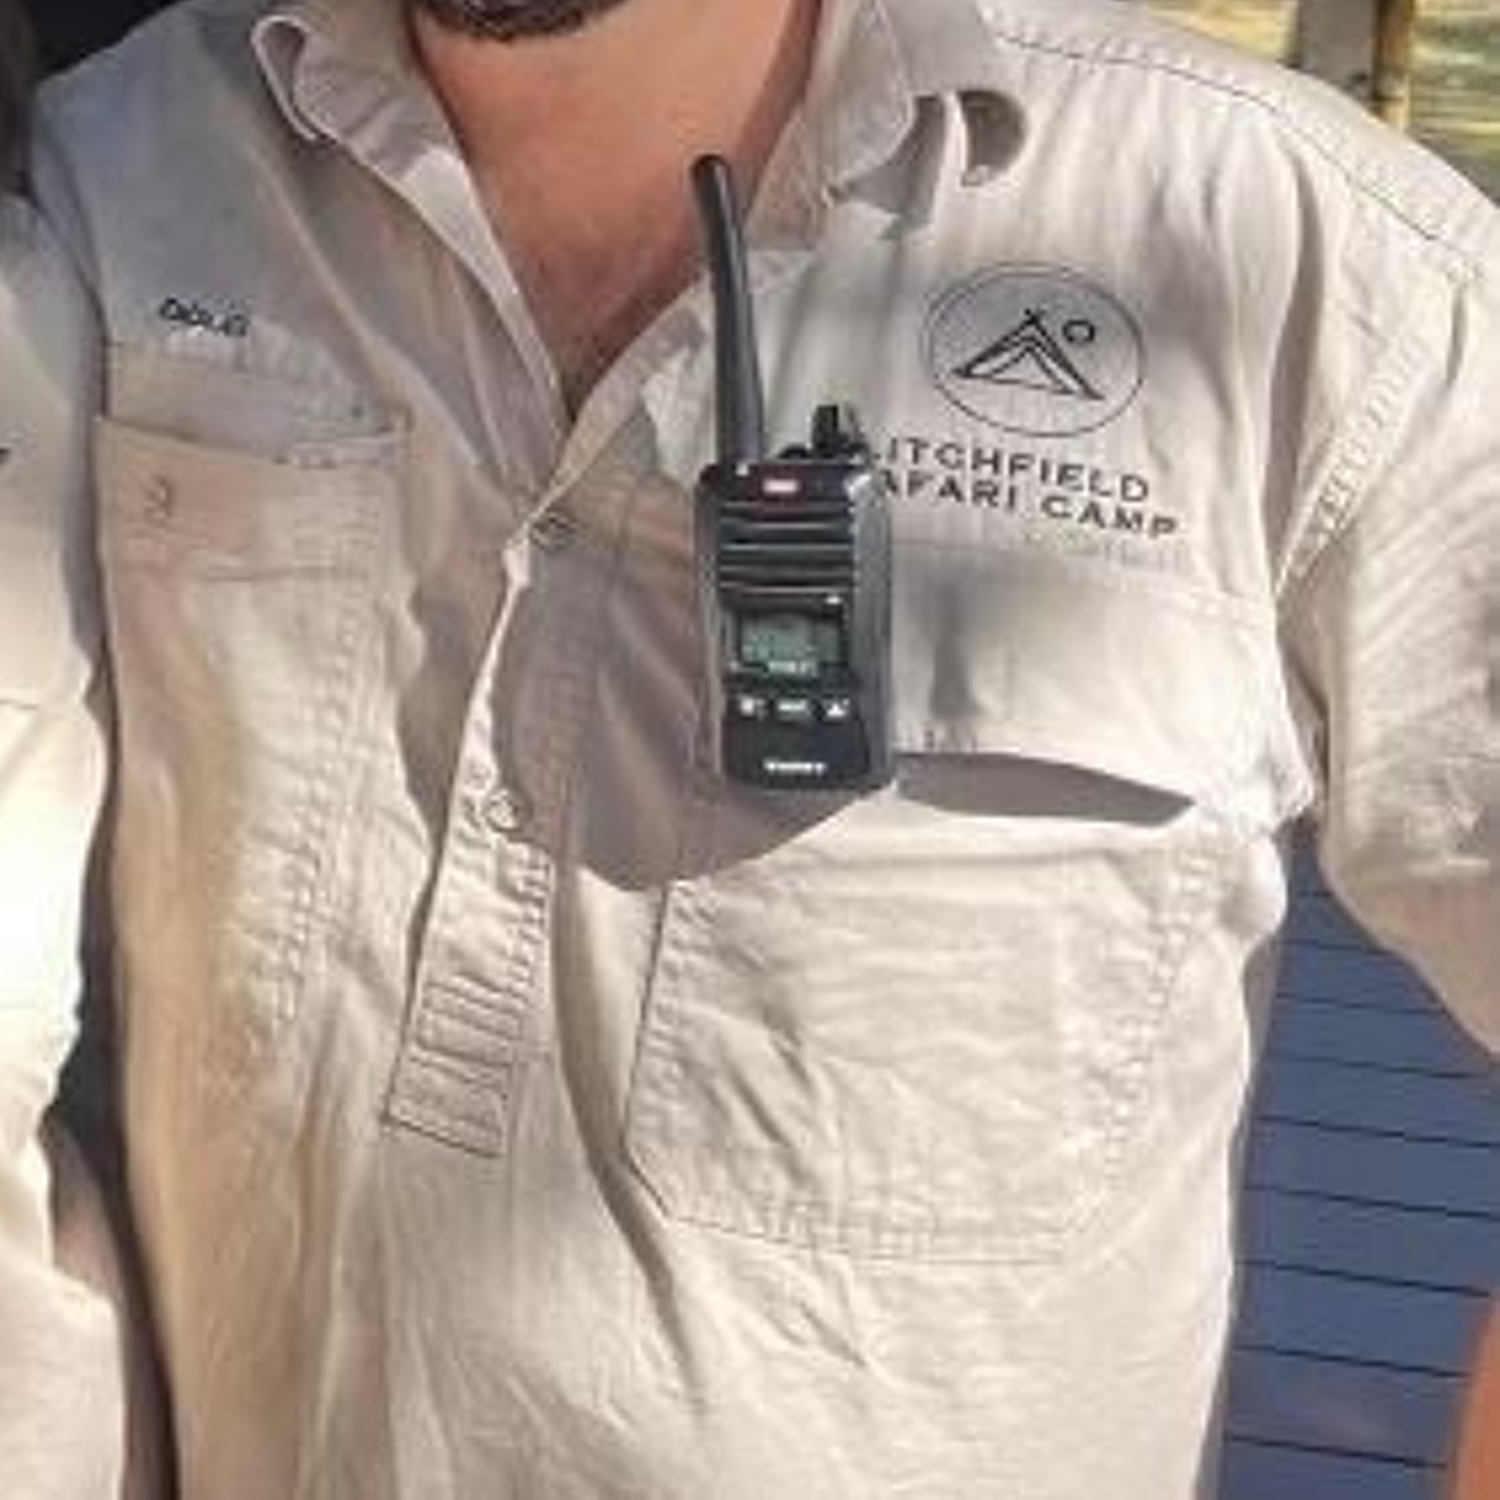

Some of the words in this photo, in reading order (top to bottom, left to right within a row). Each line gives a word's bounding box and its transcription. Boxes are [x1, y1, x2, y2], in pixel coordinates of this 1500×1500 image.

[871, 436, 1149, 502] ITCHFIELD
[878, 467, 1019, 511] AFARI
[1040, 495, 1178, 538] CAMP
